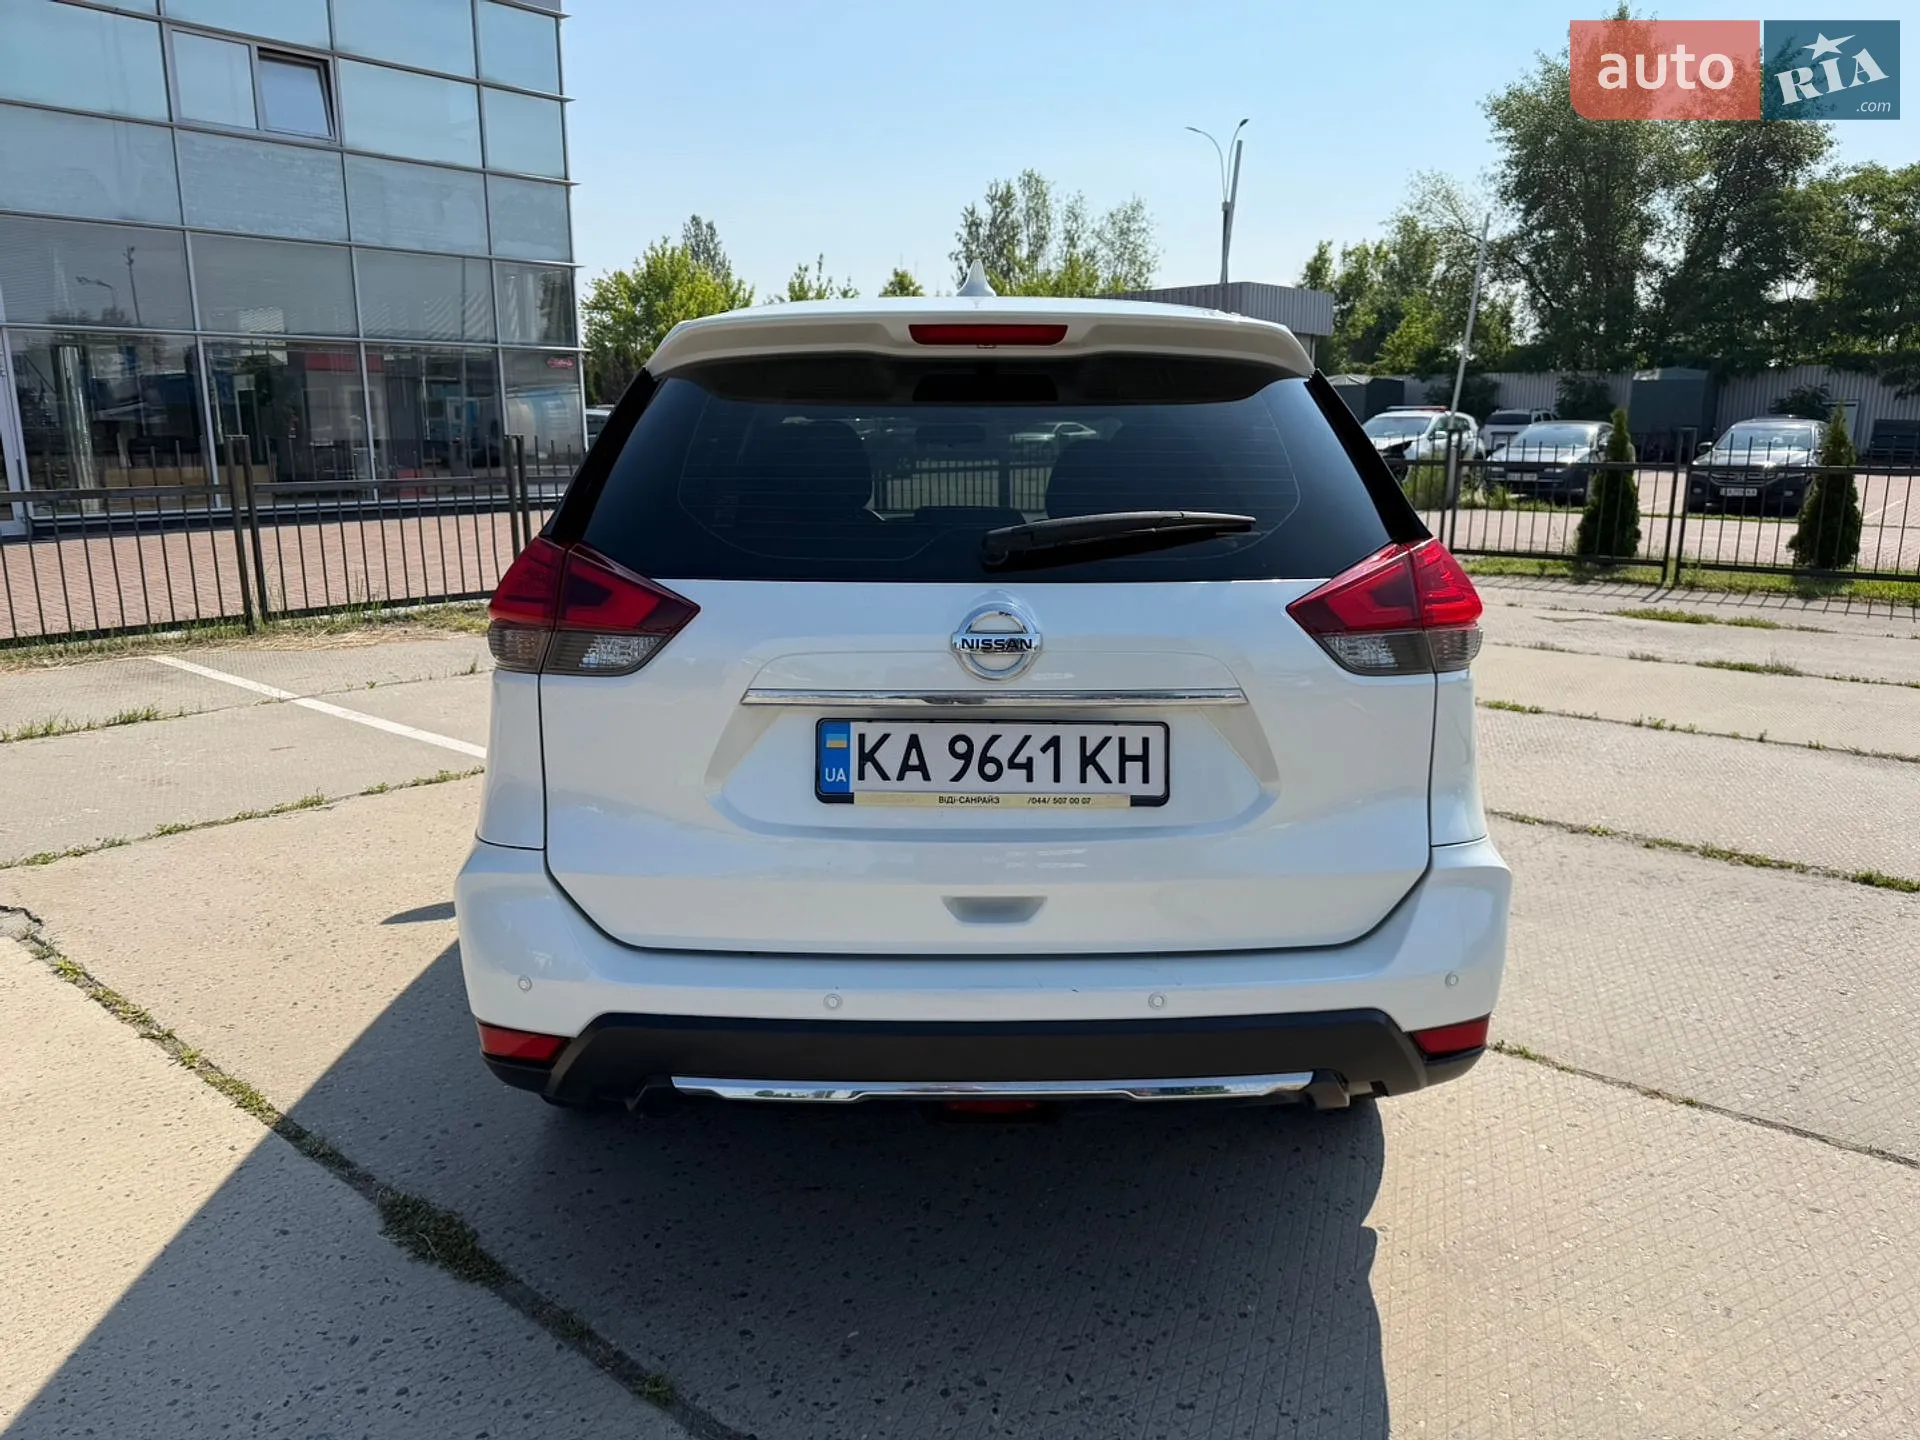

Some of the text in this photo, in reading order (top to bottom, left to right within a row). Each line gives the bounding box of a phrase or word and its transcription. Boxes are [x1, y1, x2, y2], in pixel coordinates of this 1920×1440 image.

[961, 638, 1032, 650] NISSAN
[856, 733, 1149, 784] KA 9641 KH
[825, 768, 846, 782] UA
